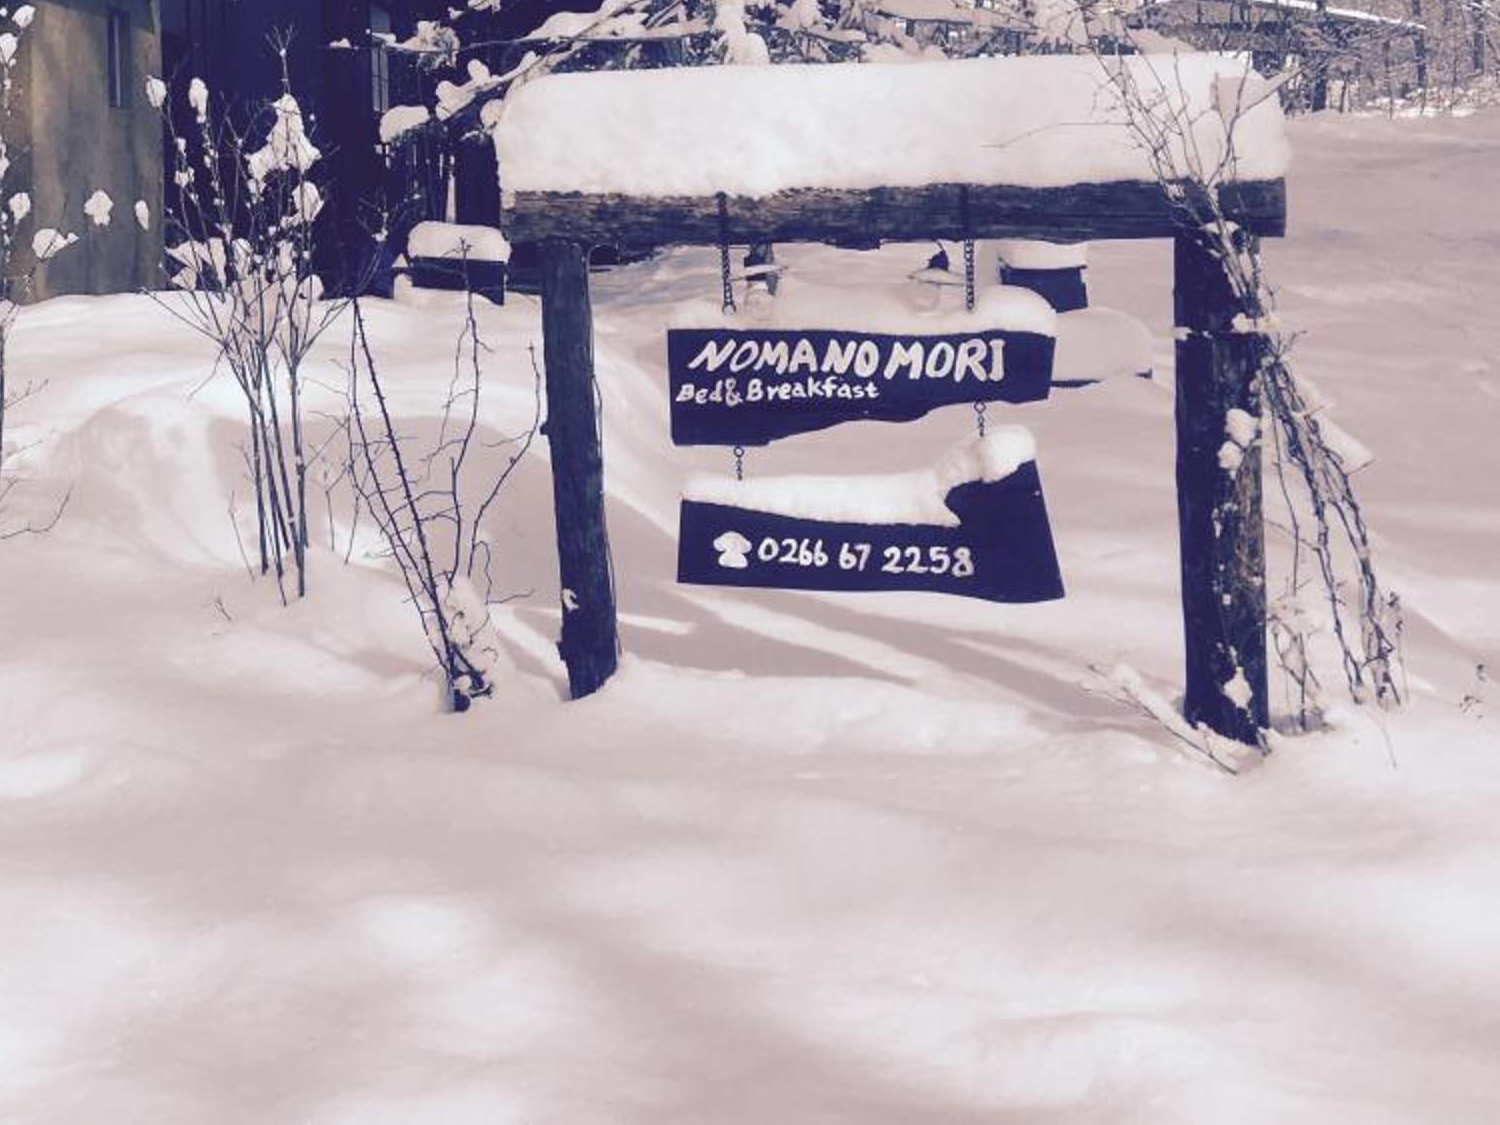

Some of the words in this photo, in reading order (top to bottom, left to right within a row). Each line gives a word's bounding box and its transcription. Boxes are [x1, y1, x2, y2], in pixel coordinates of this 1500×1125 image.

[883, 338, 1006, 383] MORI
[757, 536, 829, 567] 0266
[838, 542, 872, 572] 67
[881, 545, 975, 578] 2258
